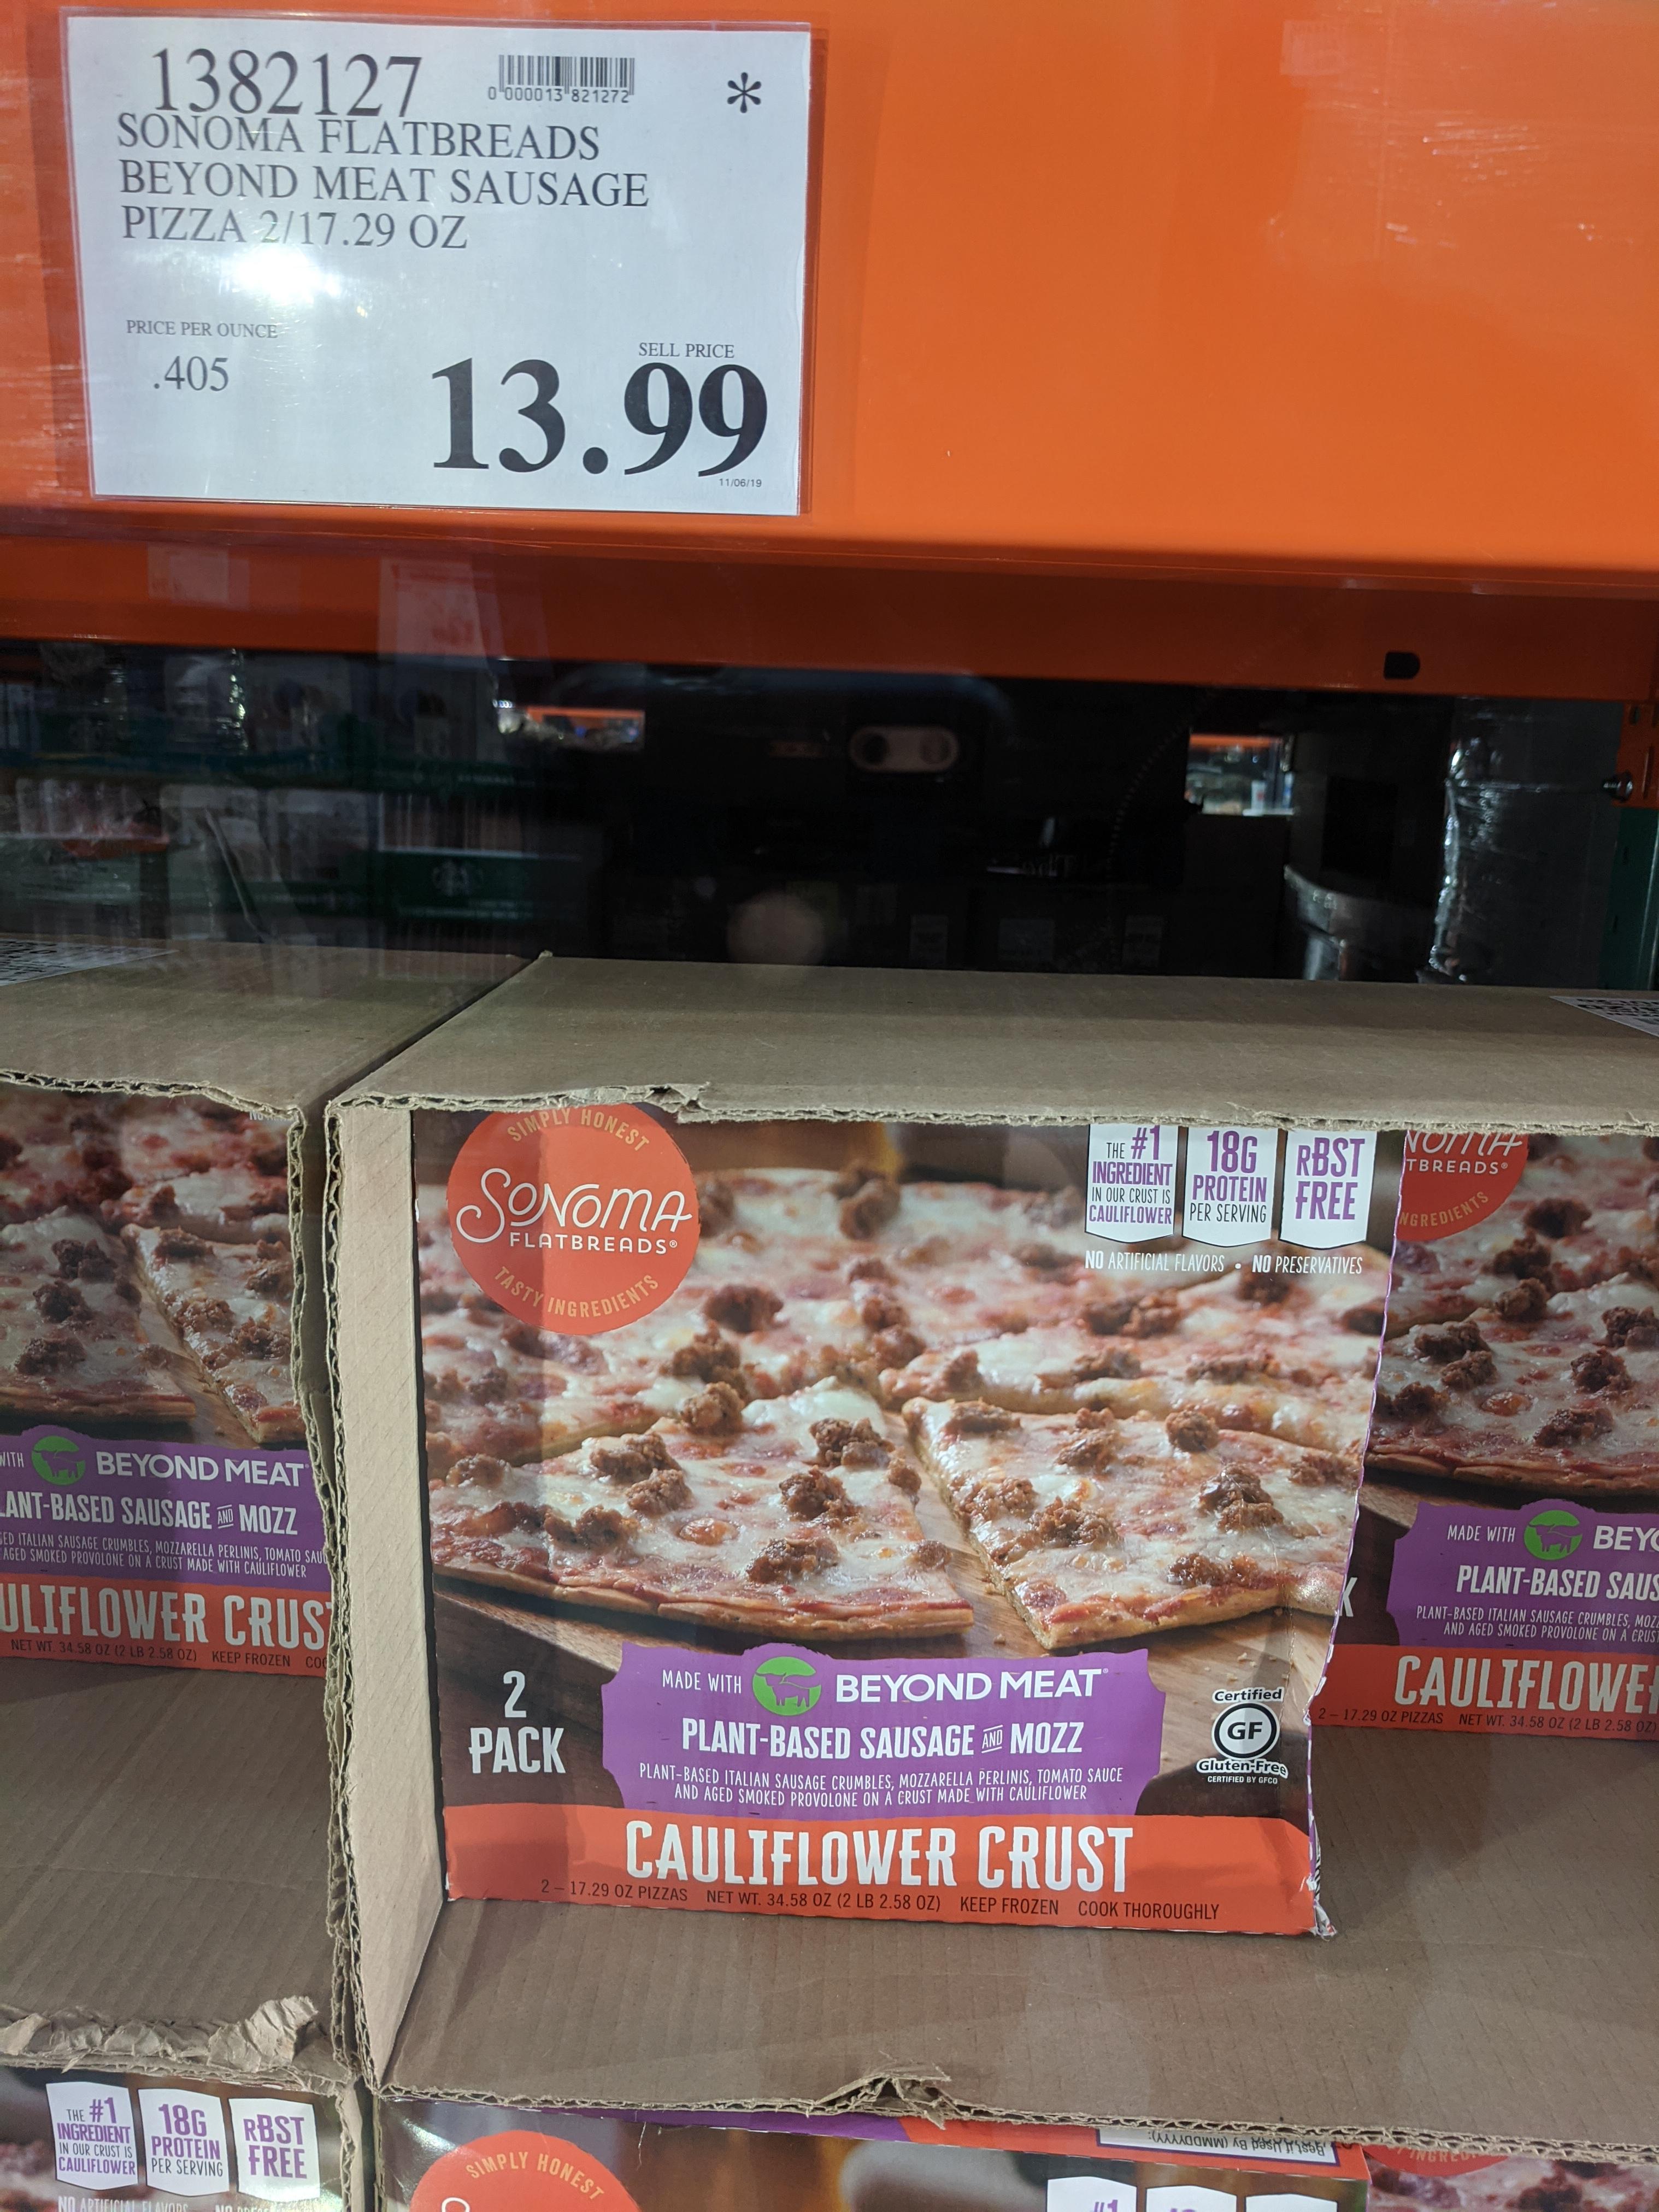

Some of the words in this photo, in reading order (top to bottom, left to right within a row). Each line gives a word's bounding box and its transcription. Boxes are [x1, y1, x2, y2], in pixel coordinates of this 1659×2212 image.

[152, 48, 422, 117] 1382127
[488, 86, 497, 100] 0
[571, 89, 630, 103] 821272
[117, 113, 305, 153] SONOMA
[318, 119, 599, 161] FLATBREADS
[119, 158, 297, 199] BEYOND
[313, 165, 436, 202] MEAT
[450, 168, 650, 208] SAUSAGE
[122, 205, 245, 243] PIZZA
[258, 209, 395, 248] 2/17.29
[409, 214, 468, 249] OZ
[126, 320, 177, 335] PRICE
[181, 321, 213, 337] PER
[217, 323, 278, 339] OUNCE
[638, 343, 680, 357] SELL
[685, 344, 735, 358] PRICE
[154, 355, 230, 392] .405
[432, 358, 768, 477] 13.99
[719, 478, 762, 487] 11/06/19
[508, 1108, 573, 1142] SIMPLY
[581, 1109, 650, 1151] HONEST
[1106, 1143, 1125, 1159] THE
[1131, 1125, 1161, 1160] #1
[1207, 1130, 1257, 1174] 18G
[1092, 1161, 1173, 1186] INGREDIENT
[1092, 1186, 1103, 1202] IN
[1105, 1187, 1126, 1203] OUR
[1129, 1187, 1160, 1204] CRUST
[1162, 1189, 1170, 1204] IS
[1192, 1174, 1268, 1202] PROTEIN
[1295, 1181, 1358, 1220] FREE
[1089, 1204, 1172, 1225] CAULIFLOWER
[1190, 1203, 1211, 1222] PER
[1216, 1204, 1267, 1223] SERVING
[1085, 1250, 1104, 1269] NO
[1108, 1251, 1170, 1272] ARTIFICIAL
[1175, 1253, 1225, 1273] FLAVORS
[1252, 1254, 1271, 1274] NO
[1275, 1255, 1363, 1274] PRESERVATIVES
[495, 1266, 544, 1308] TASTY
[547, 1274, 659, 1318] INGREDIENTS
[96, 1451, 219, 1480] BEYOND
[121, 1497, 212, 1529] SAUSAGE
[217, 1507, 233, 1525] AND
[239, 1504, 298, 1535] MOZZ
[19, 1533, 54, 1548] ITALIAN
[58, 1534, 98, 1550] SAUSAGE
[102, 1537, 152, 1554] CRUMBLES,
[156, 1540, 214, 1557] MOZZARELLA
[218, 1544, 262, 1561] PERLINIS,
[264, 1547, 301, 1562] TOMATO
[1447, 1525, 1480, 1542] MADE
[1486, 1526, 1516, 1543] WITH
[4, 1548, 26, 1561] AGED
[30, 1549, 67, 1563] SMOKED
[72, 1551, 125, 1567] PROVOLONE
[244, 1562, 307, 1578] CAULIFLOWER
[1456, 1564, 1601, 1599] PLANT-BASED
[1416, 1605, 1484, 1621] PLANT-BASED
[1488, 1607, 1526, 1622] ITALIAN
[1531, 1609, 1574, 1625] SAUSAGE
[1578, 1611, 1631, 1628] CRUMBLES,
[212, 1650, 241, 1664] KEEP
[245, 1652, 290, 1668] FROZEN
[503, 1670, 527, 1717] 2
[662, 1669, 701, 1690] MADE
[708, 1672, 742, 1693] WITH
[836, 1673, 992, 1702] BEYOND
[1214, 1688, 1282, 1703] Certified
[682, 1717, 850, 1760] PLANT-BASED
[860, 1725, 975, 1758] SAUSAGE
[983, 1729, 1003, 1749] AND
[1010, 1721, 1084, 1754] MOZZ
[1227, 1721, 1262, 1740] GF
[468, 1727, 566, 1774] PACK
[639, 1763, 719, 1784] PLANT-BASED
[725, 1769, 769, 1788] ITALIAN
[775, 1772, 826, 1790] SAUSAGE
[832, 1774, 895, 1791] CRUMBLES,
[899, 1772, 973, 1788] MOZZARELLA
[979, 1769, 1032, 1787] PERLINIS,
[1038, 1768, 1083, 1784] TOMATO
[1087, 1767, 1123, 1782] SAUCE
[1199, 1760, 1286, 1775] Gluten-Free
[1207, 1775, 1244, 1784] CERTIFIED
[1258, 1776, 1278, 1785] GFCO
[674, 1783, 698, 1800] AND
[703, 1786, 733, 1802] AGED
[738, 1788, 785, 1806] SMOKED
[791, 1790, 857, 1808] PROVOLONE
[863, 1791, 880, 1806] ON
[885, 1790, 892, 1805] A
[898, 1789, 932, 1805] CRUST
[937, 1788, 970, 1803] MADE
[975, 1786, 1004, 1802] WITH
[1009, 1784, 1087, 1802] CAULIFLOWER
[626, 1820, 957, 1886] CAULIFLOWER
[978, 1826, 1133, 1893] CRUST
[541, 1879, 550, 1894] 2
[570, 1880, 609, 1897] 17.29
[614, 1884, 633, 1899] OZ
[638, 1886, 687, 1902] PIZZAS
[707, 1889, 733, 1904] NET
[738, 1891, 761, 1905] WT.
[767, 1892, 807, 1907] 34.58
[813, 1892, 832, 1907] OZ
[837, 1893, 850, 1909] (2
[856, 1893, 874, 1908] LB
[879, 1894, 911, 1909] 2.58
[916, 1895, 941, 1912] OZ)
[960, 1896, 996, 1912] KEEP
[1002, 1898, 1058, 1915] FROZEN
[1078, 1901, 1118, 1917] COOK
[1123, 1902, 1219, 1920] THOROUGHLY
[67, 2109, 84, 2122] THE
[89, 2097, 116, 2123] #1
[158, 2104, 207, 2137] 18G
[57, 2123, 131, 2144] INGREDIENT
[1233, 2138, 1246, 2150] By
[59, 2143, 69, 2155] IN
[73, 2144, 90, 2156] OUR
[94, 2144, 121, 2157] CRUST
[124, 2146, 132, 2158] IS
[151, 2136, 220, 2160] PROTEIN
[249, 2145, 307, 2179] FREE
[58, 2156, 136, 2175] CAULIFLOWER
[151, 2158, 172, 2174] PER
[177, 2161, 223, 2177] SERVING
[466, 2151, 528, 2179] SIMPLY
[537, 2154, 605, 2200] HONEST
